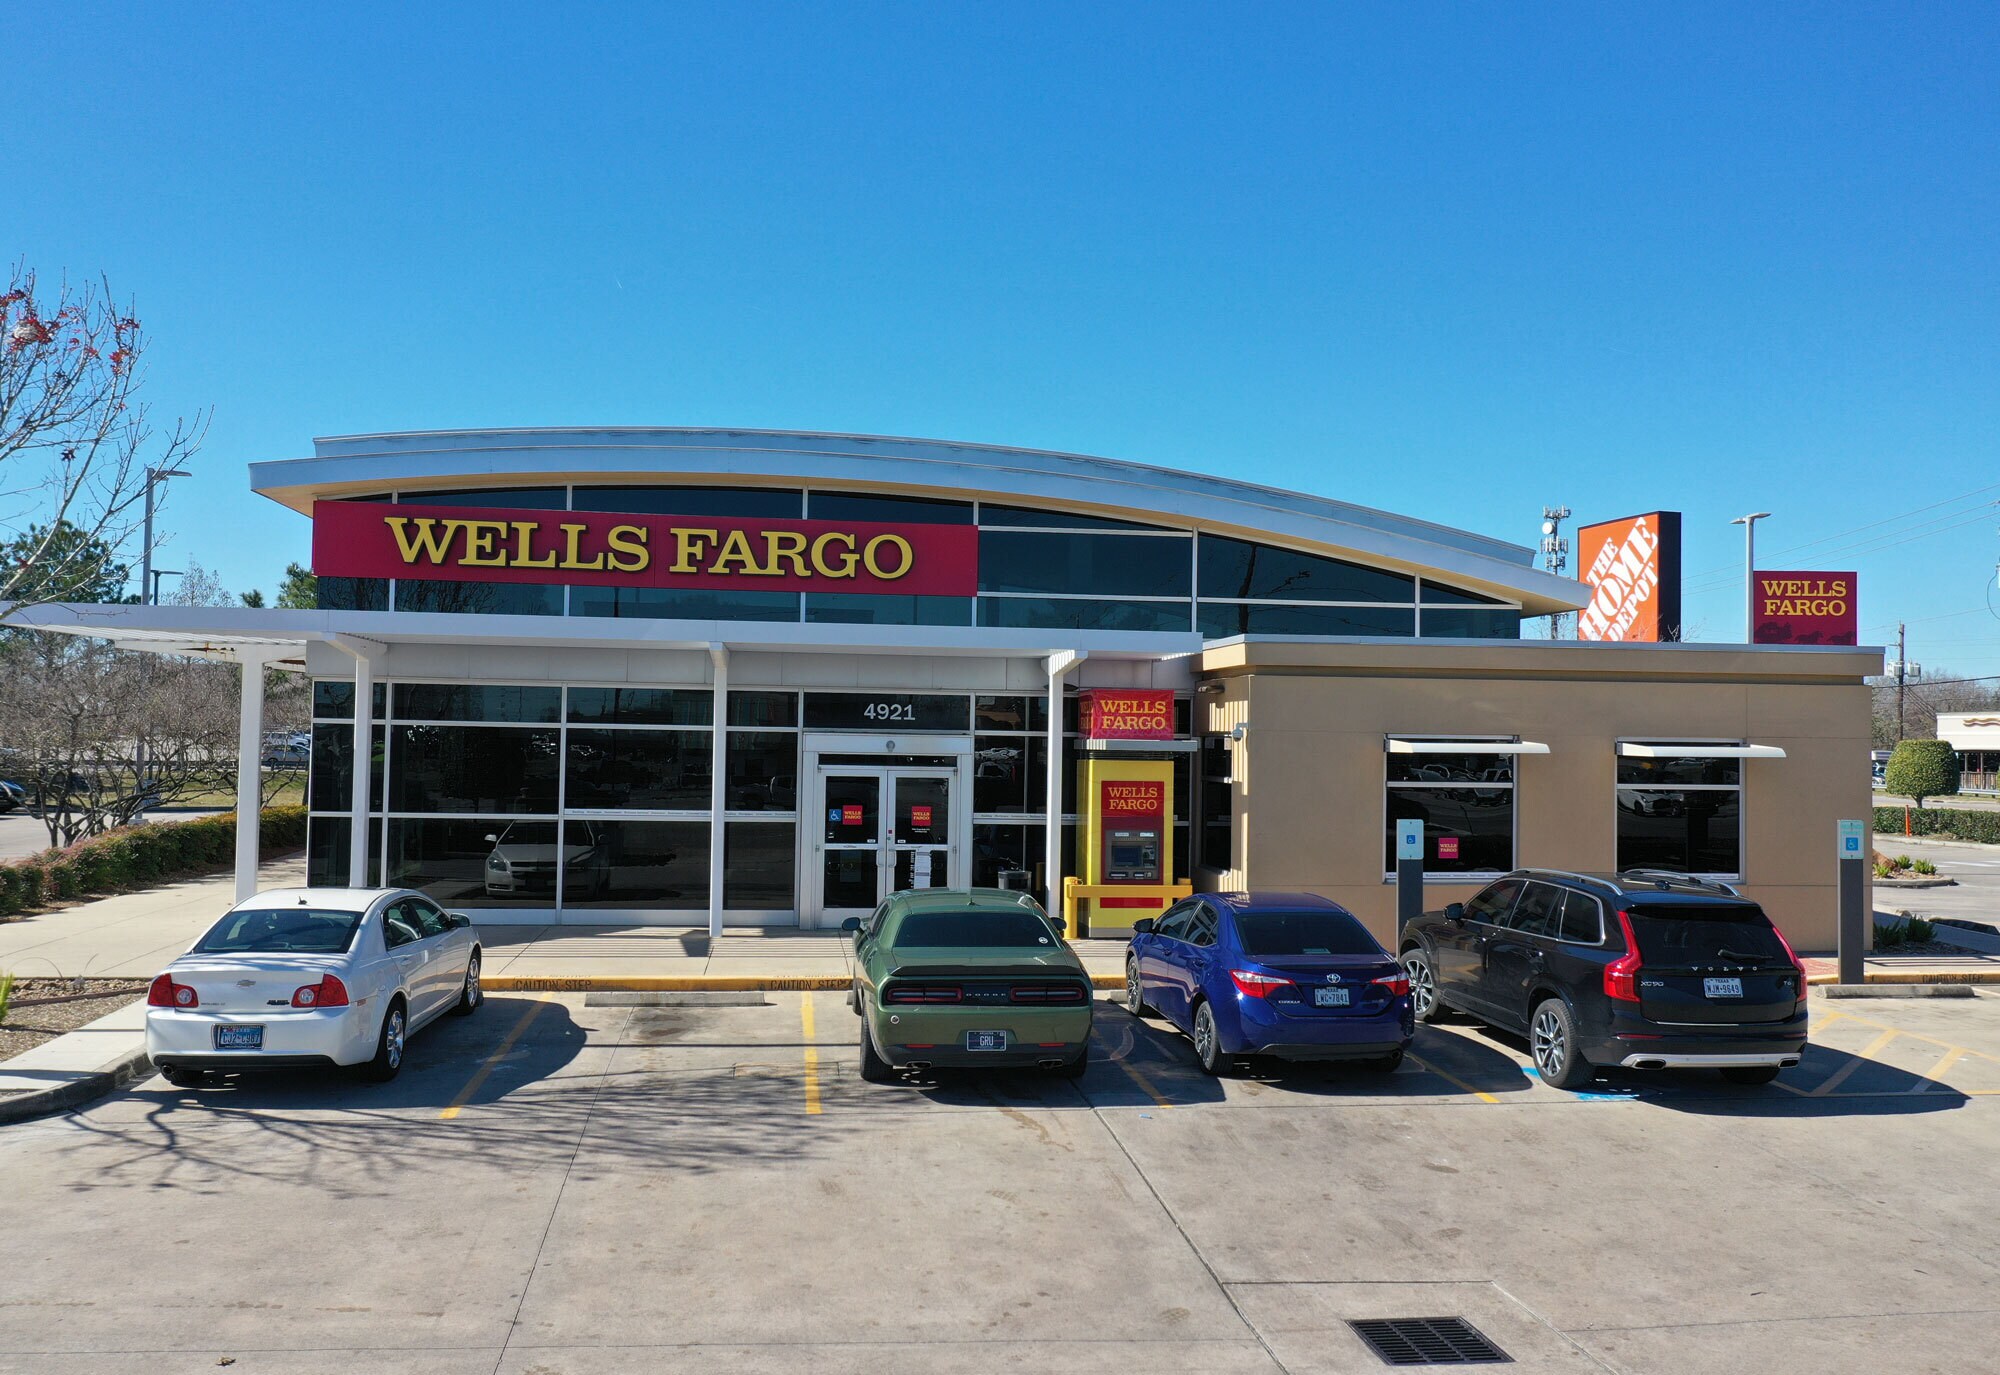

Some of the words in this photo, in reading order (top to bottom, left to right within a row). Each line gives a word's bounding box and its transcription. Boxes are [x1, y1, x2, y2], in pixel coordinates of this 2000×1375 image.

[384, 516, 650, 573] WELLS
[668, 527, 915, 580] FARGO
[1586, 537, 1620, 588] THE
[1579, 517, 1658, 641] HOME
[1761, 580, 1847, 597] WELLS
[1607, 561, 1658, 642] DEPOT
[1764, 600, 1846, 616] FARGO
[863, 703, 916, 721] 4921
[1100, 700, 1166, 714] WELLS
[1101, 716, 1166, 730] FARGO
[1108, 787, 1158, 798] WELLS
[1109, 799, 1157, 810] FARGO
[515, 980, 559, 991] CAUTION
[565, 980, 592, 991] STEP
[770, 980, 812, 991] CAUTION
[818, 979, 845, 990] STEP
[1922, 974, 1956, 984] CAUTION
[1960, 974, 1984, 983] STEP
[979, 1035, 994, 1046] GRU
